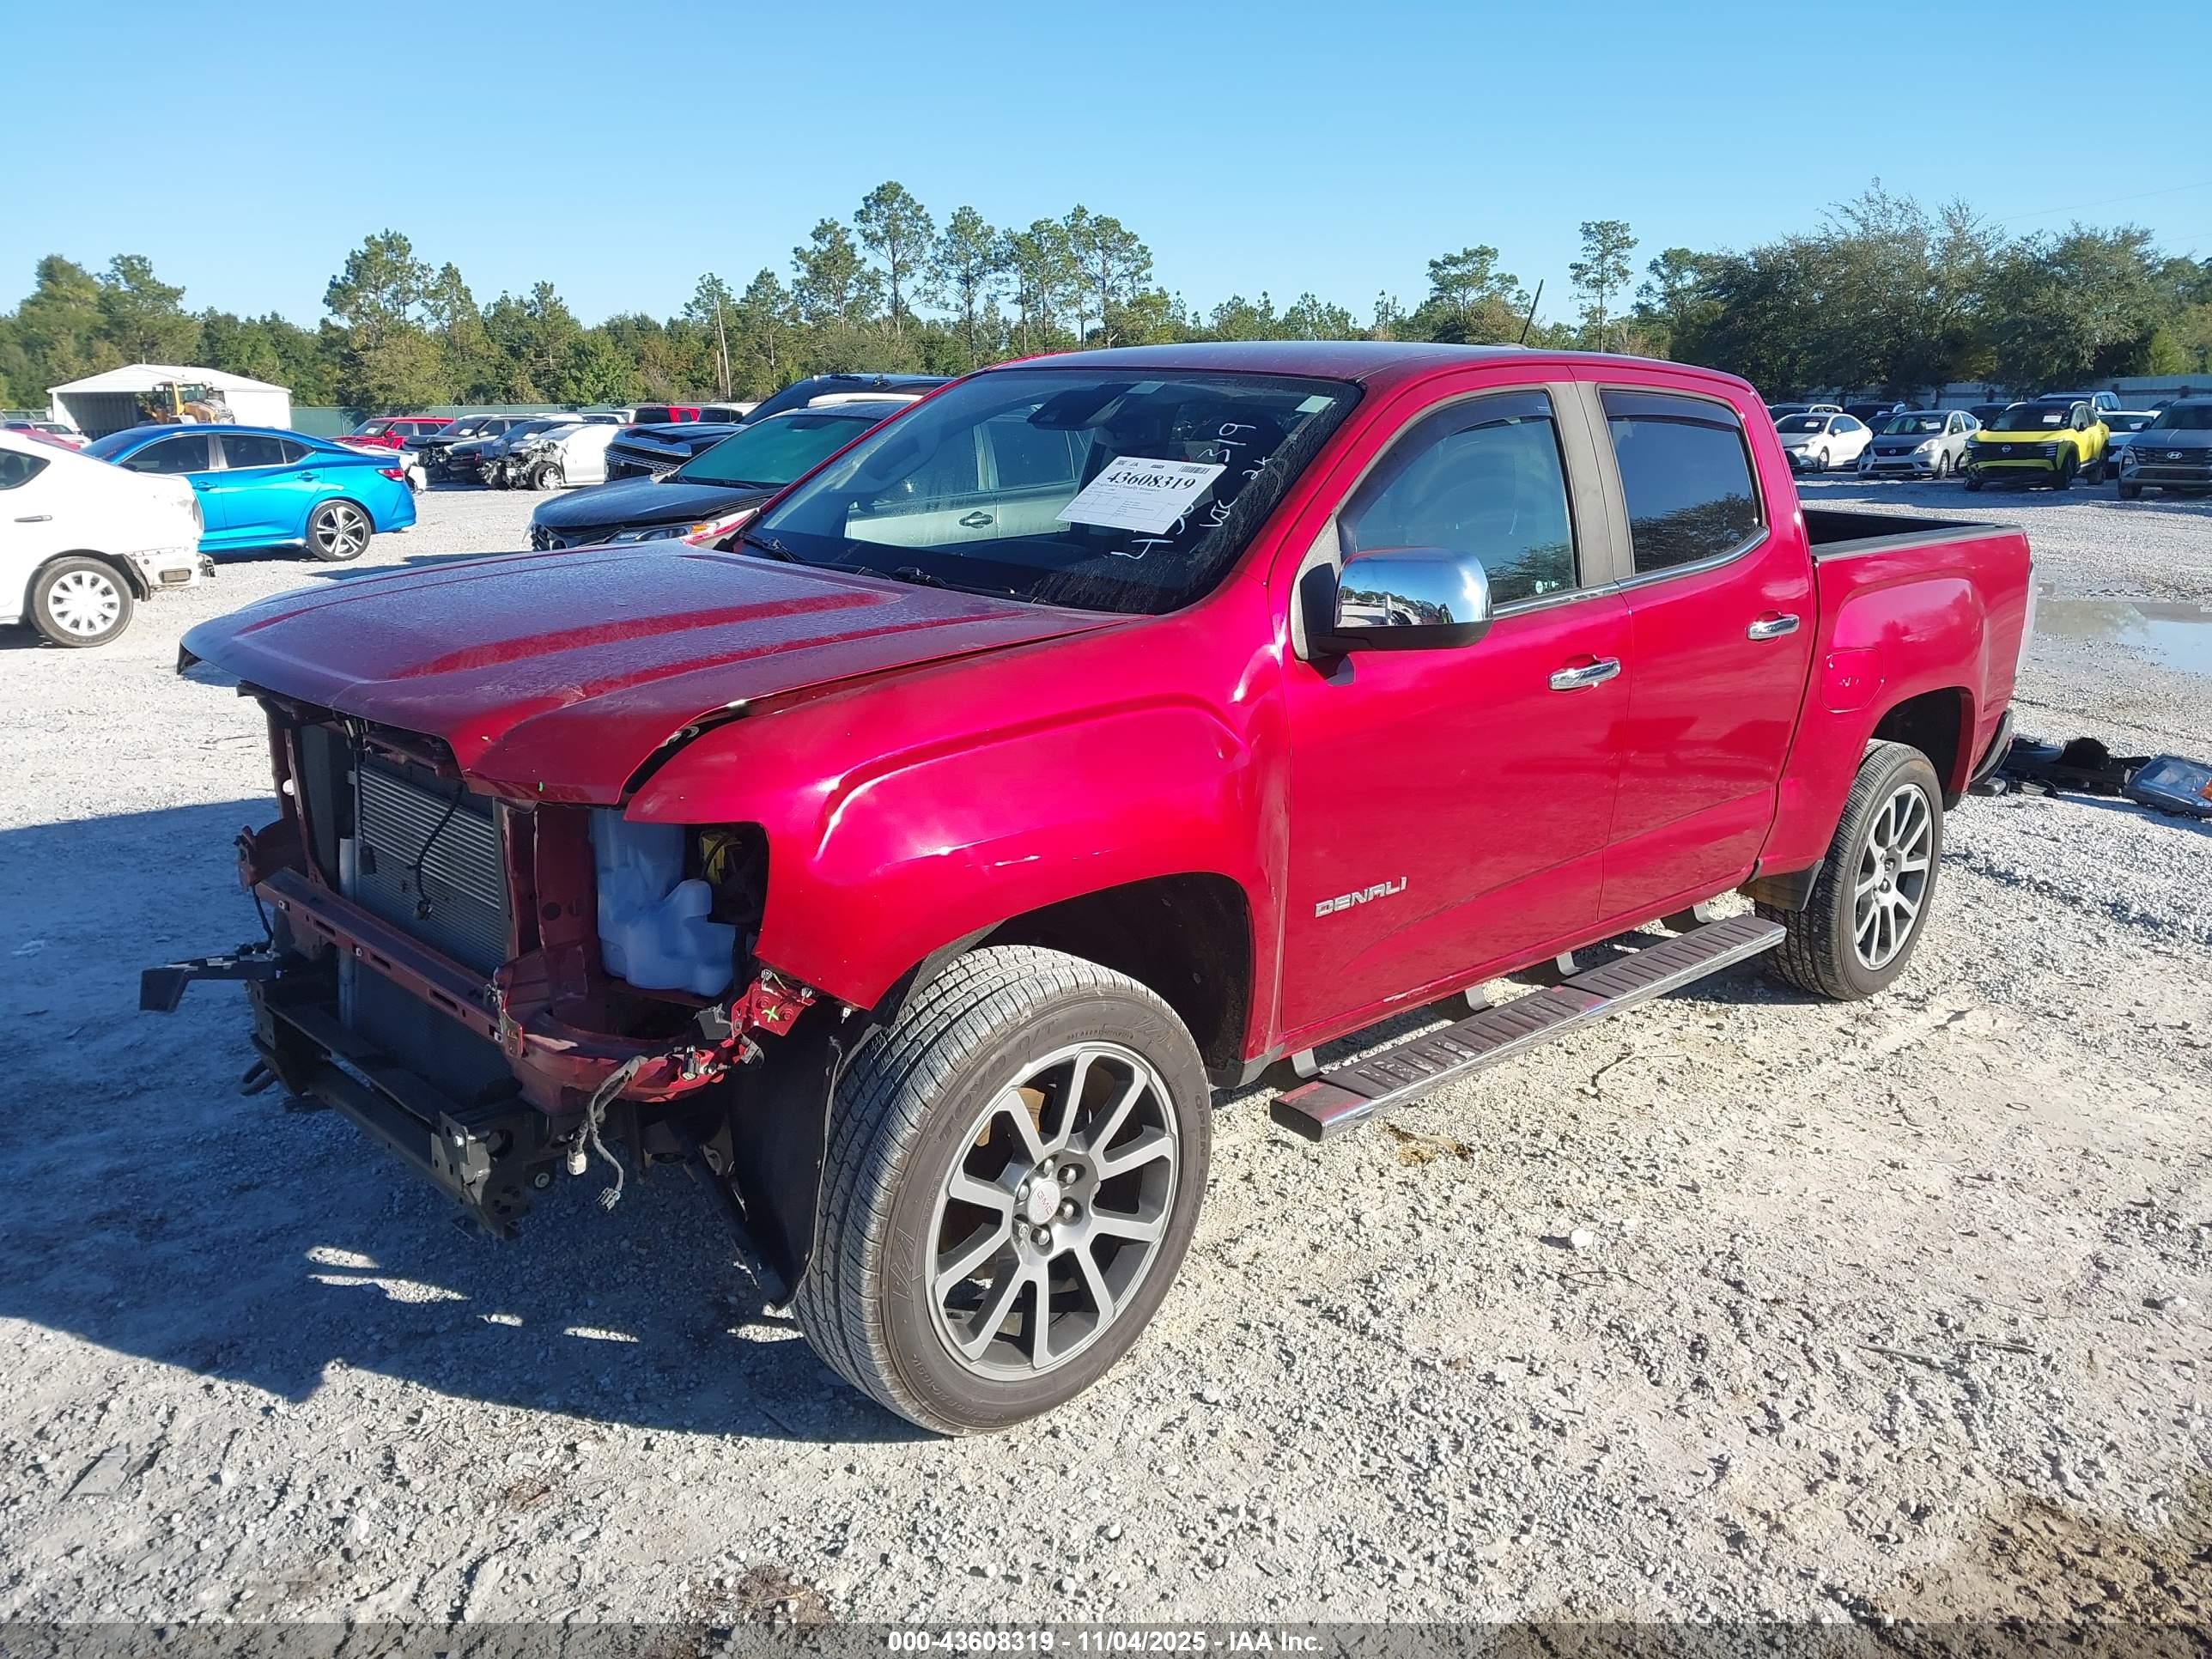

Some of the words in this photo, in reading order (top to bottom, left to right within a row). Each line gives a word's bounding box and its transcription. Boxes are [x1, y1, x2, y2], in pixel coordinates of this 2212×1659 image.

[1106, 471, 1196, 491] 43608319
[1314, 876, 1407, 919] DENALI
[1194, 1092, 1207, 1158] OPEN
[1037, 1188, 1054, 1215] GMC
